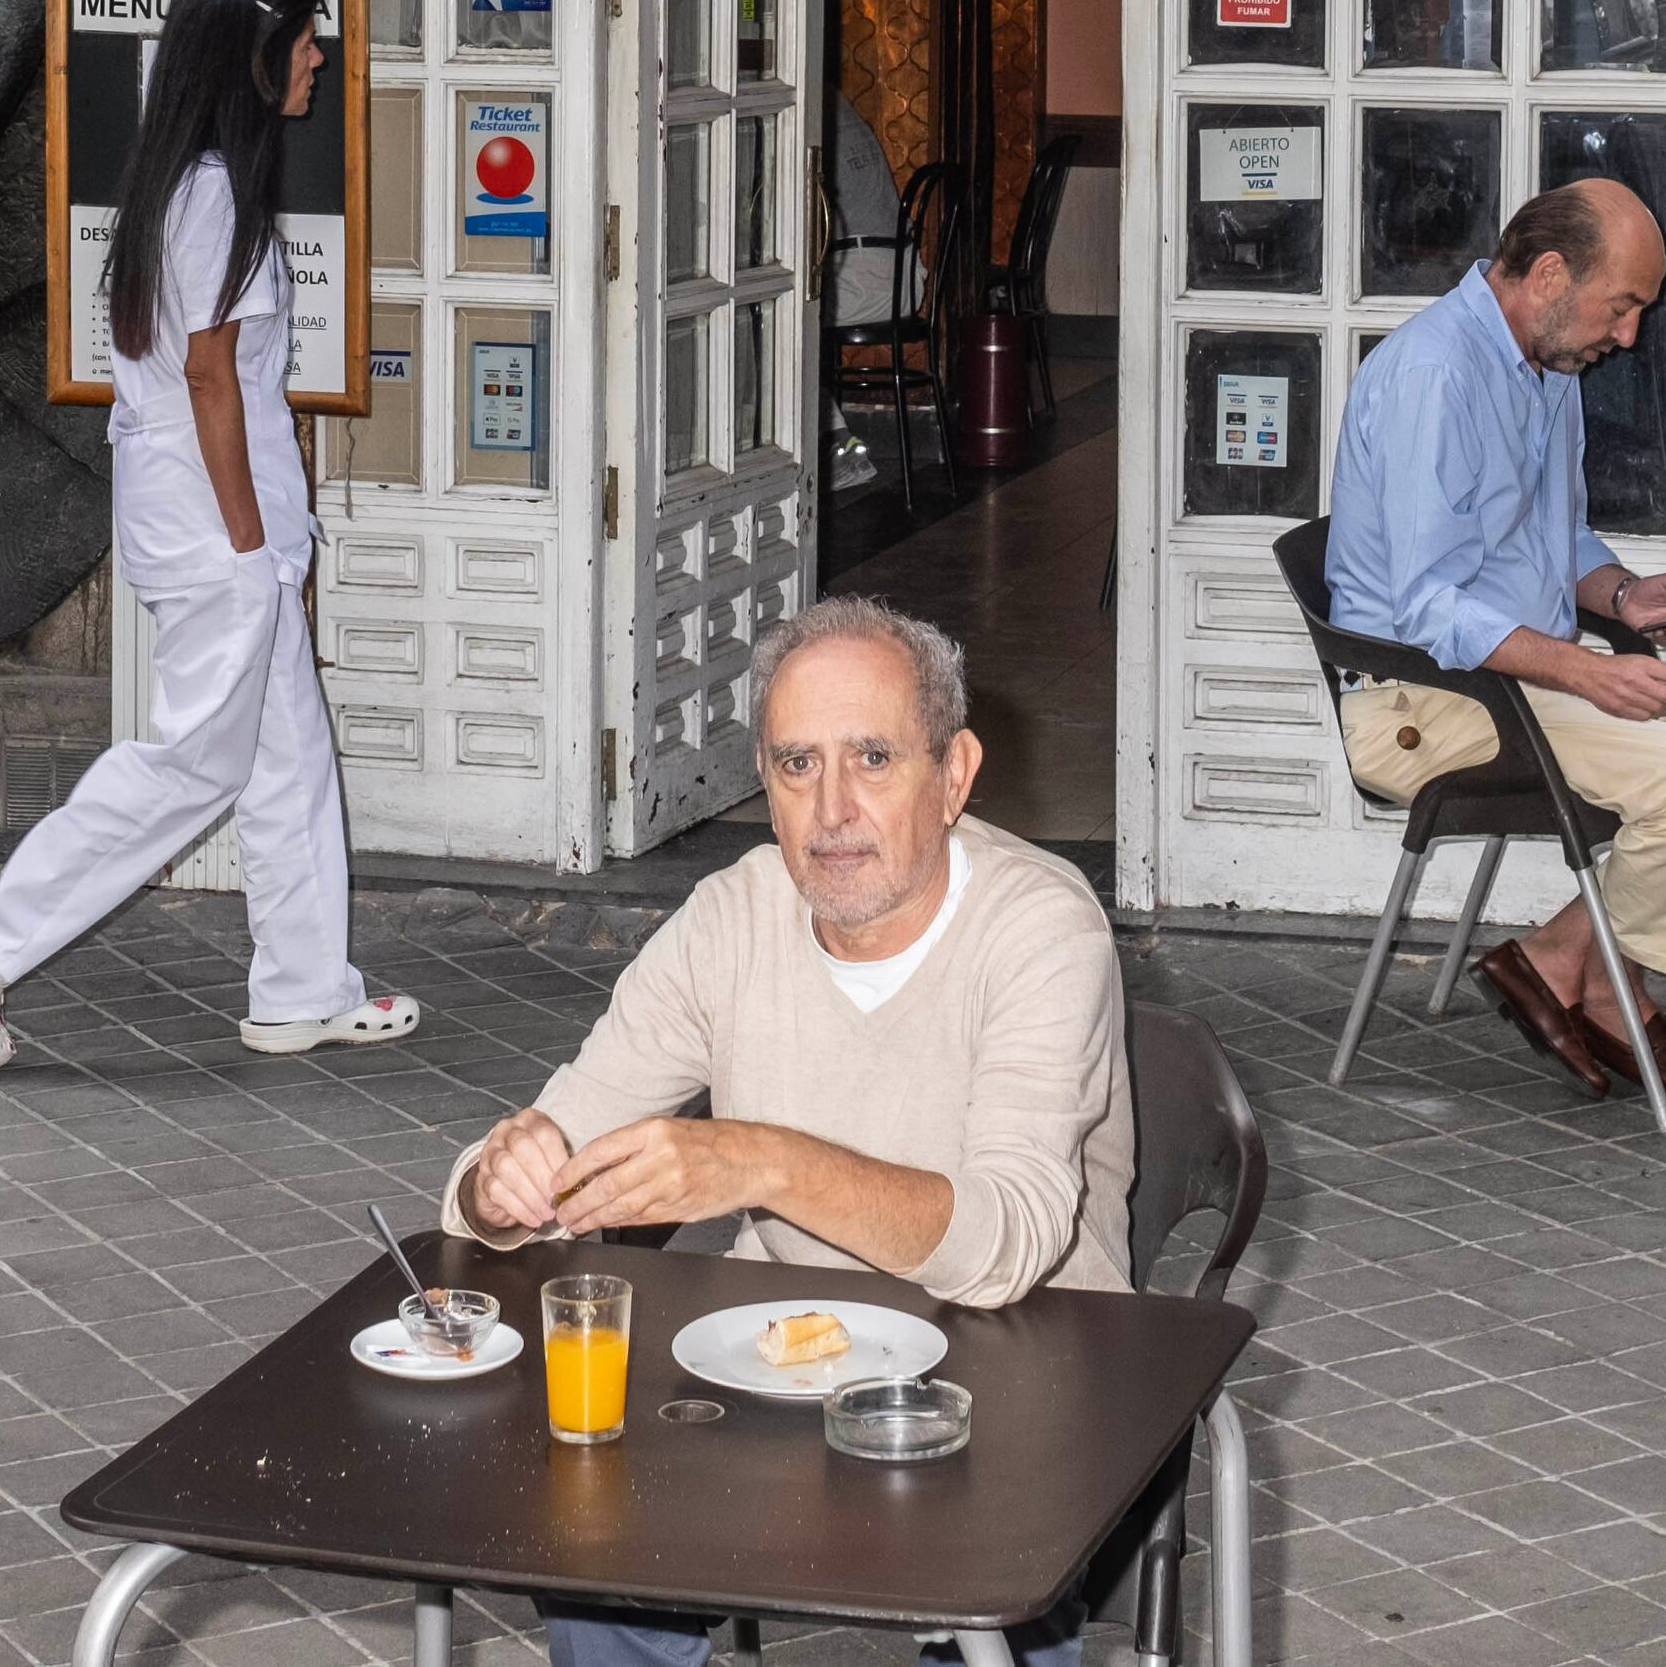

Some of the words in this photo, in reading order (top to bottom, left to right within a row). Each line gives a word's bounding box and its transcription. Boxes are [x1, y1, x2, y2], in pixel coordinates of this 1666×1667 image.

[1237, 7, 1271, 15] FUMAR
[478, 106, 533, 121] Ticket
[470, 120, 541, 132] Restaurant
[1229, 137, 1290, 152] ABIERTO
[1239, 156, 1280, 169] OPEN
[1247, 179, 1274, 189] VISA
[370, 361, 405, 377] VISA
